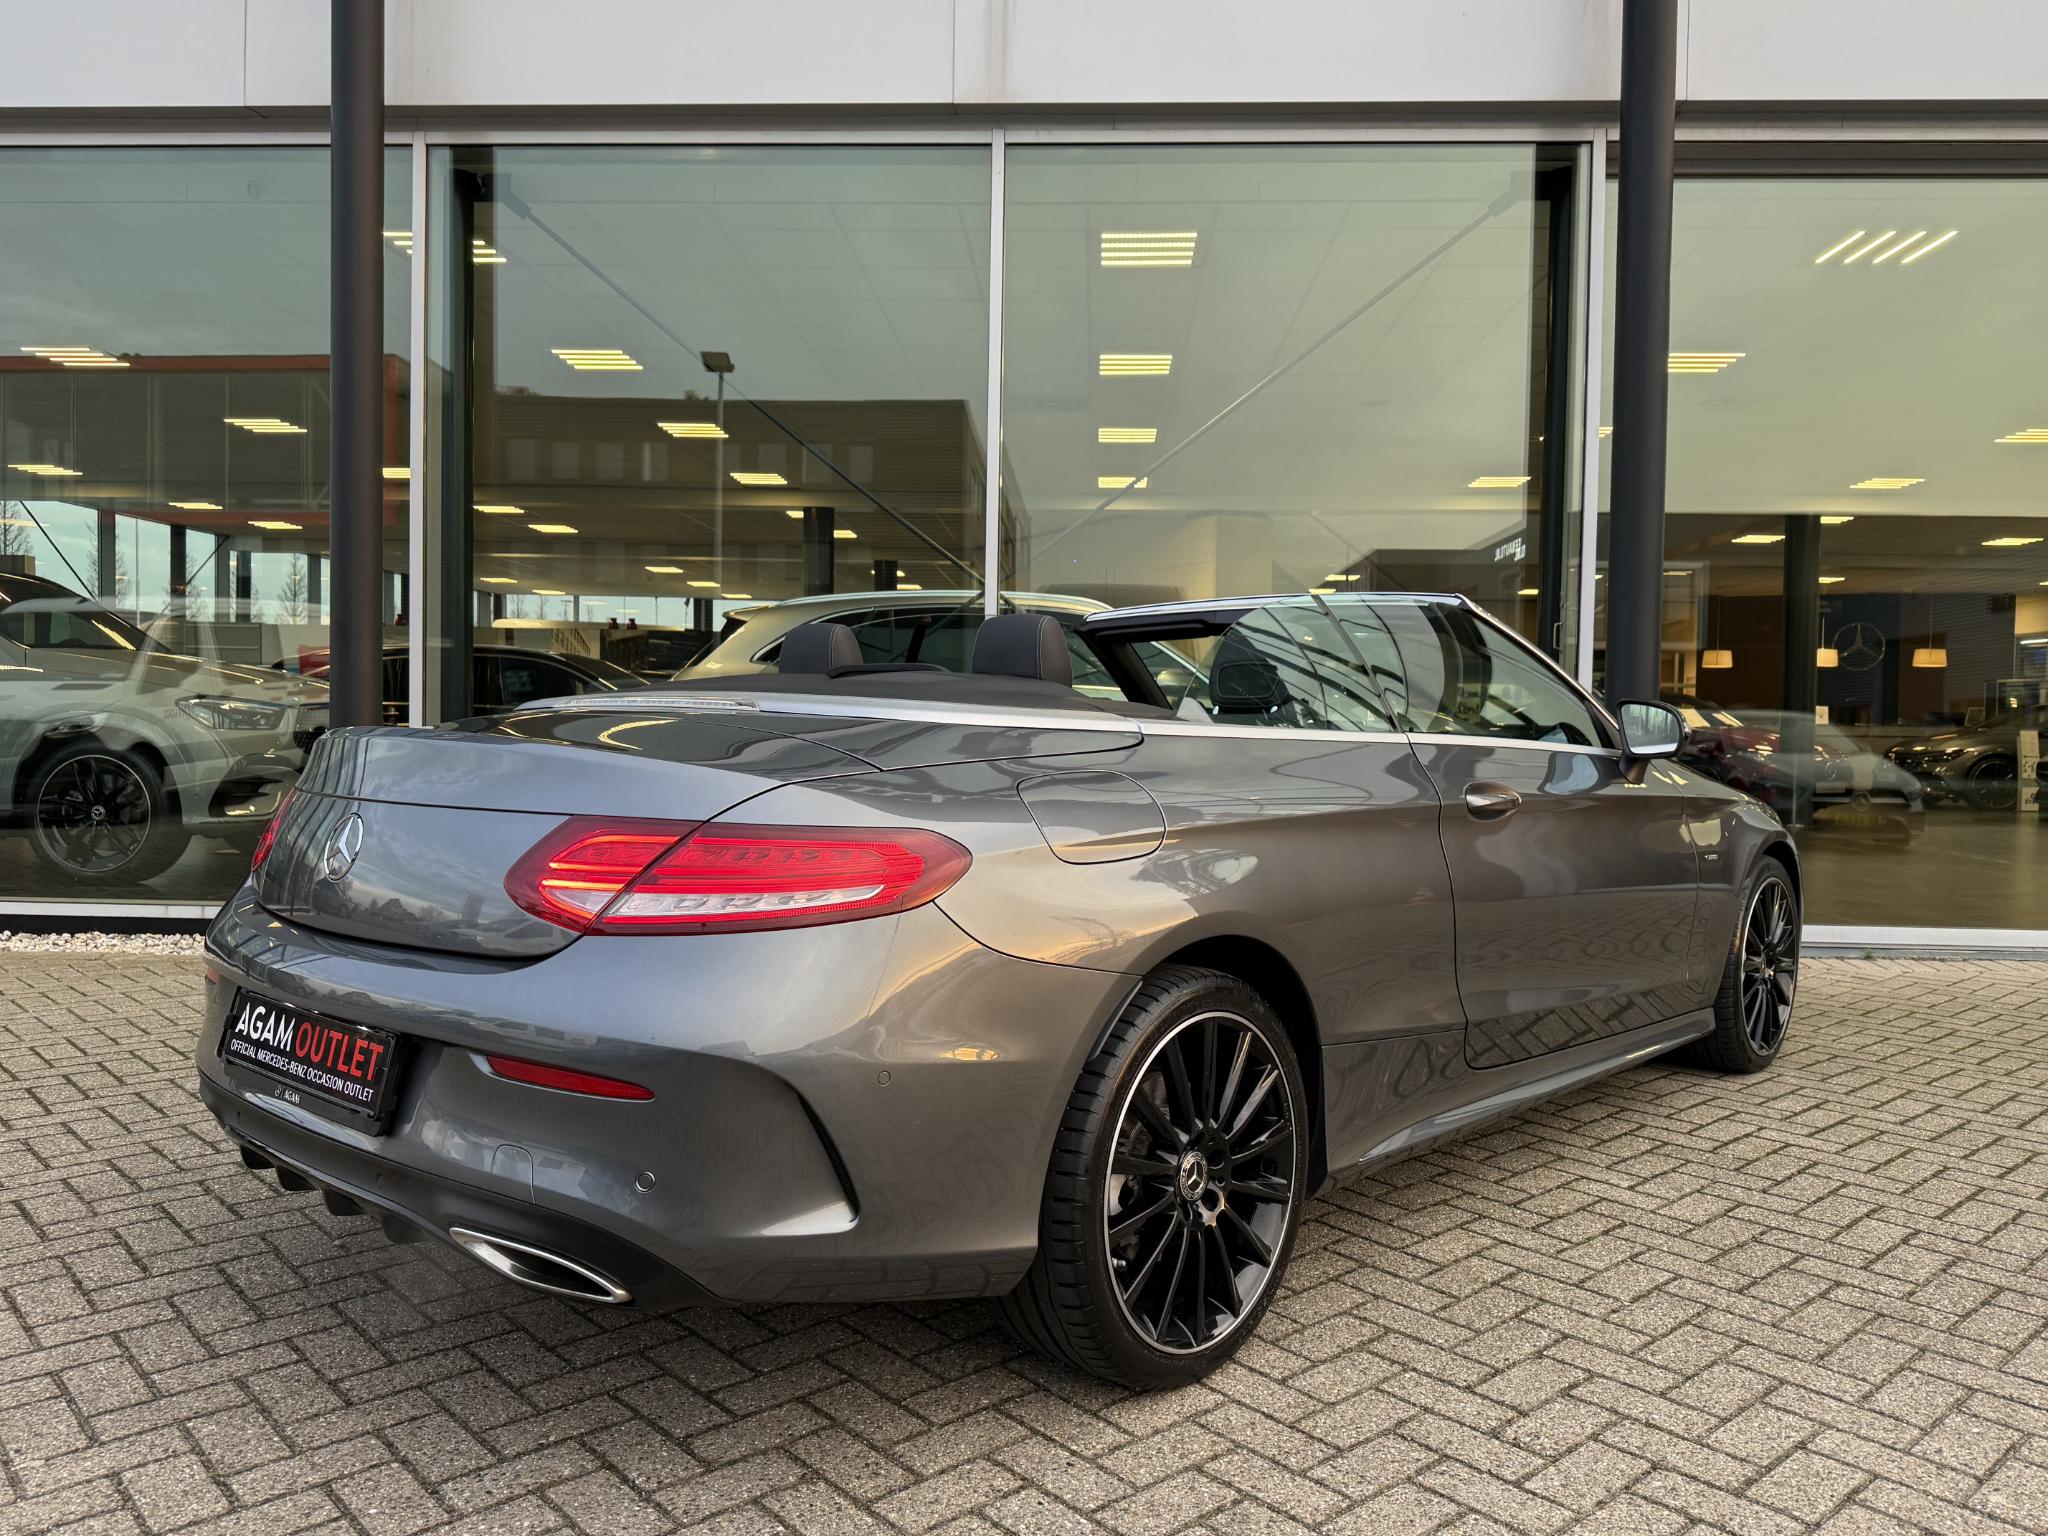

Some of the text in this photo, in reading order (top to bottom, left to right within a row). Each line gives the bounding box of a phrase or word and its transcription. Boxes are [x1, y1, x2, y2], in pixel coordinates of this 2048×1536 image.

[230, 1038, 374, 1103] OFFICIAL MERCEDES-BENZ OCCASION OUTLET
[235, 1002, 384, 1081] AGAM OUTLET
